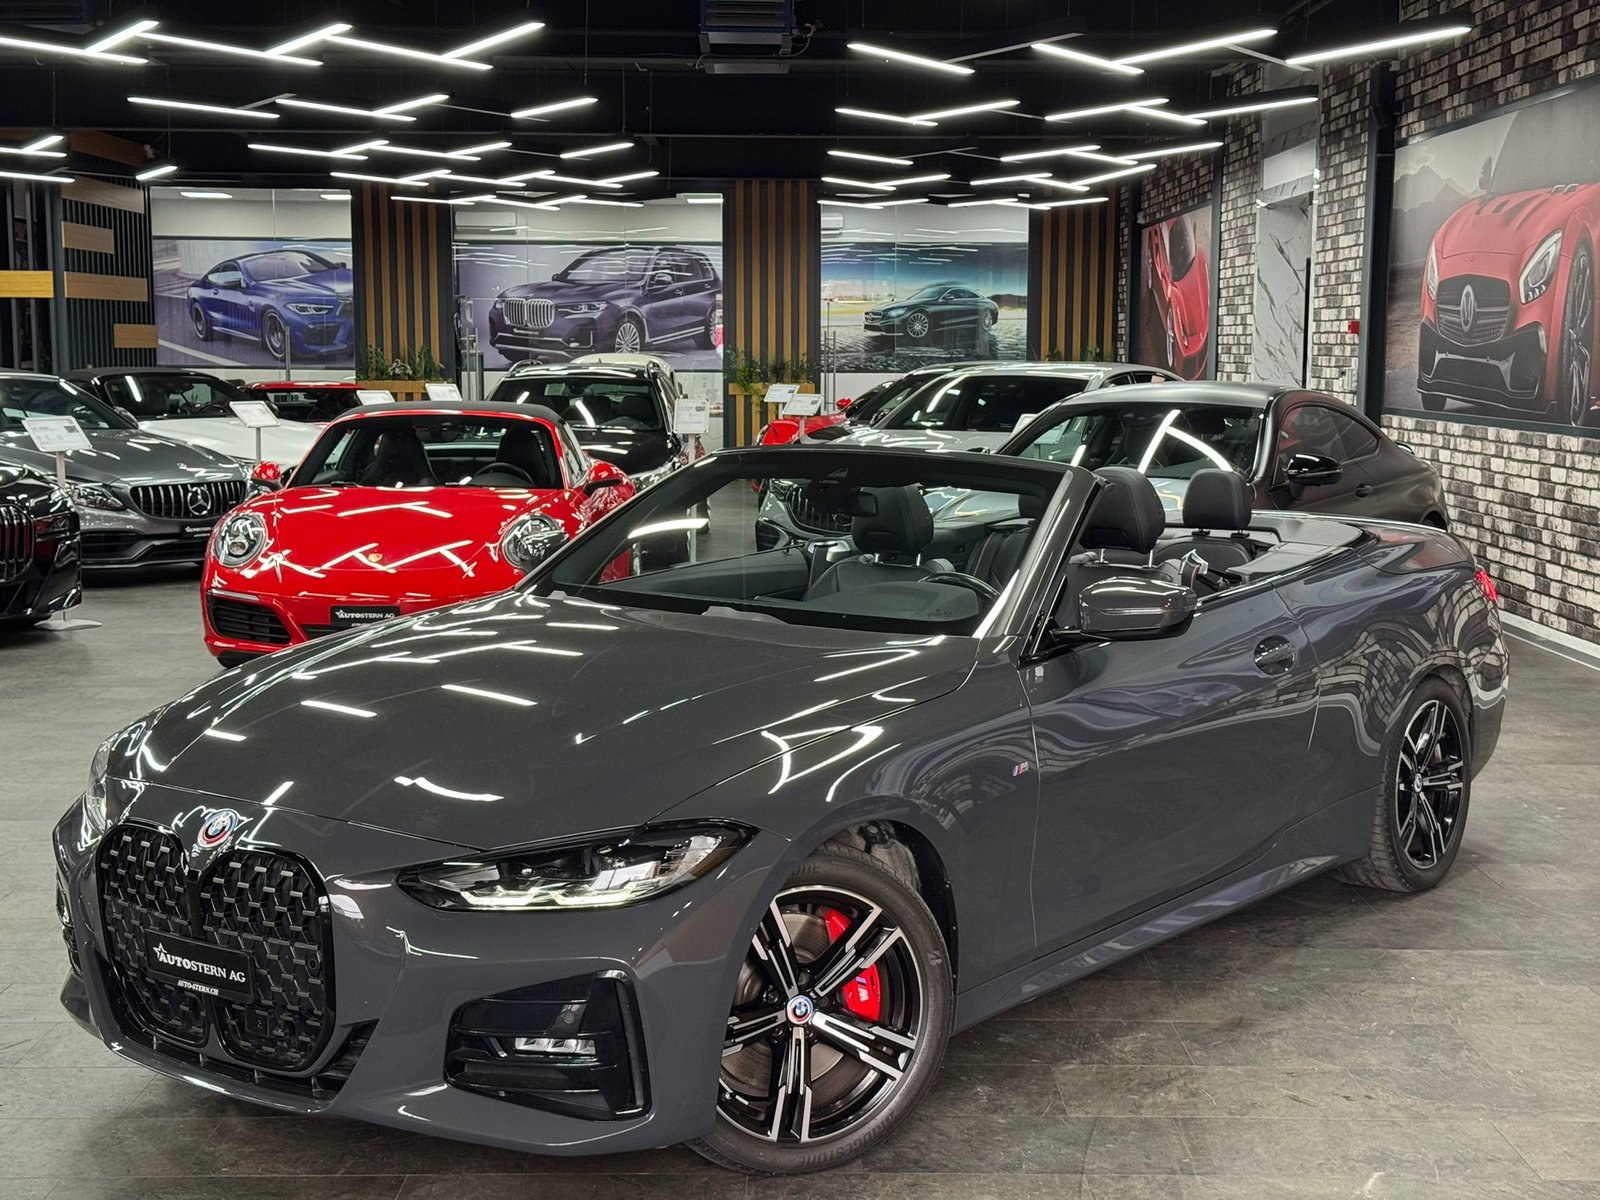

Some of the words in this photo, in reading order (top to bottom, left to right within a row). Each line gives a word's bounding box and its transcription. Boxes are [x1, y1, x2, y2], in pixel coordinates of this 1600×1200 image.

[159, 952, 227, 979] AUTOSTERN
[229, 970, 246, 983] AG
[176, 979, 219, 996] AUTO-STERN.CH
